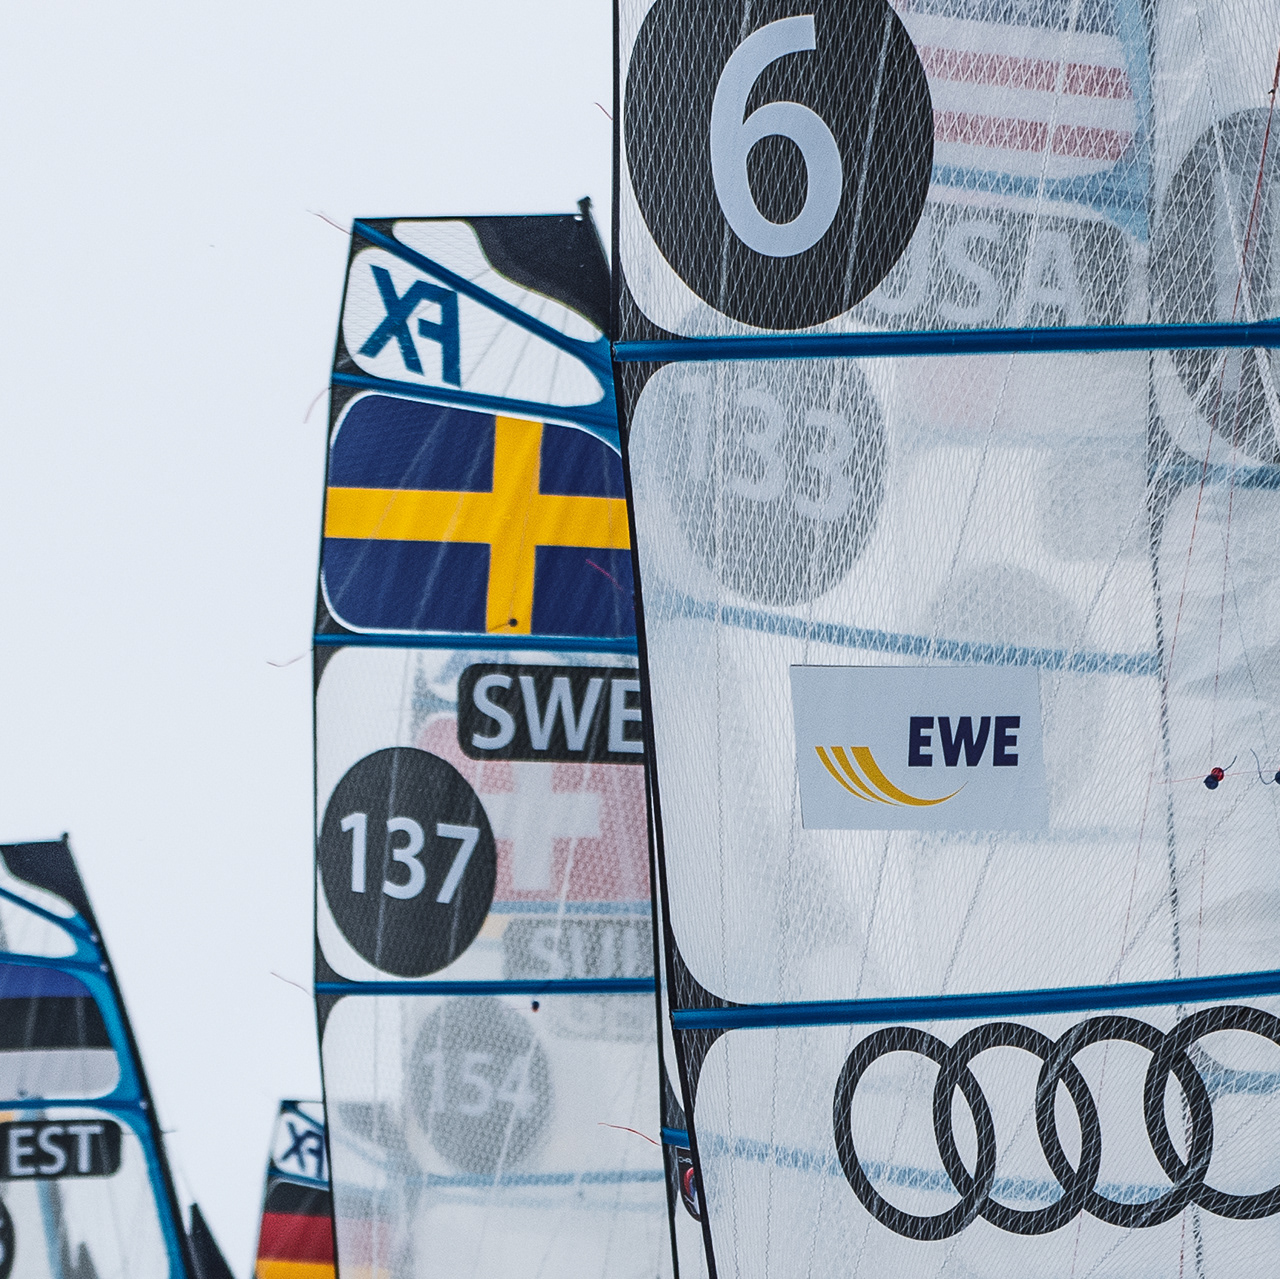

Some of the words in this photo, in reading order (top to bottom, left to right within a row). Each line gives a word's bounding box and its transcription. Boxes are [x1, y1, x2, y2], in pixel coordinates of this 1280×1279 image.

[710, 15, 843, 258] 6
[472, 674, 643, 753] SWE
[908, 716, 1021, 768] EWE
[339, 812, 482, 906] 137
[6, 1125, 105, 1176] EST
